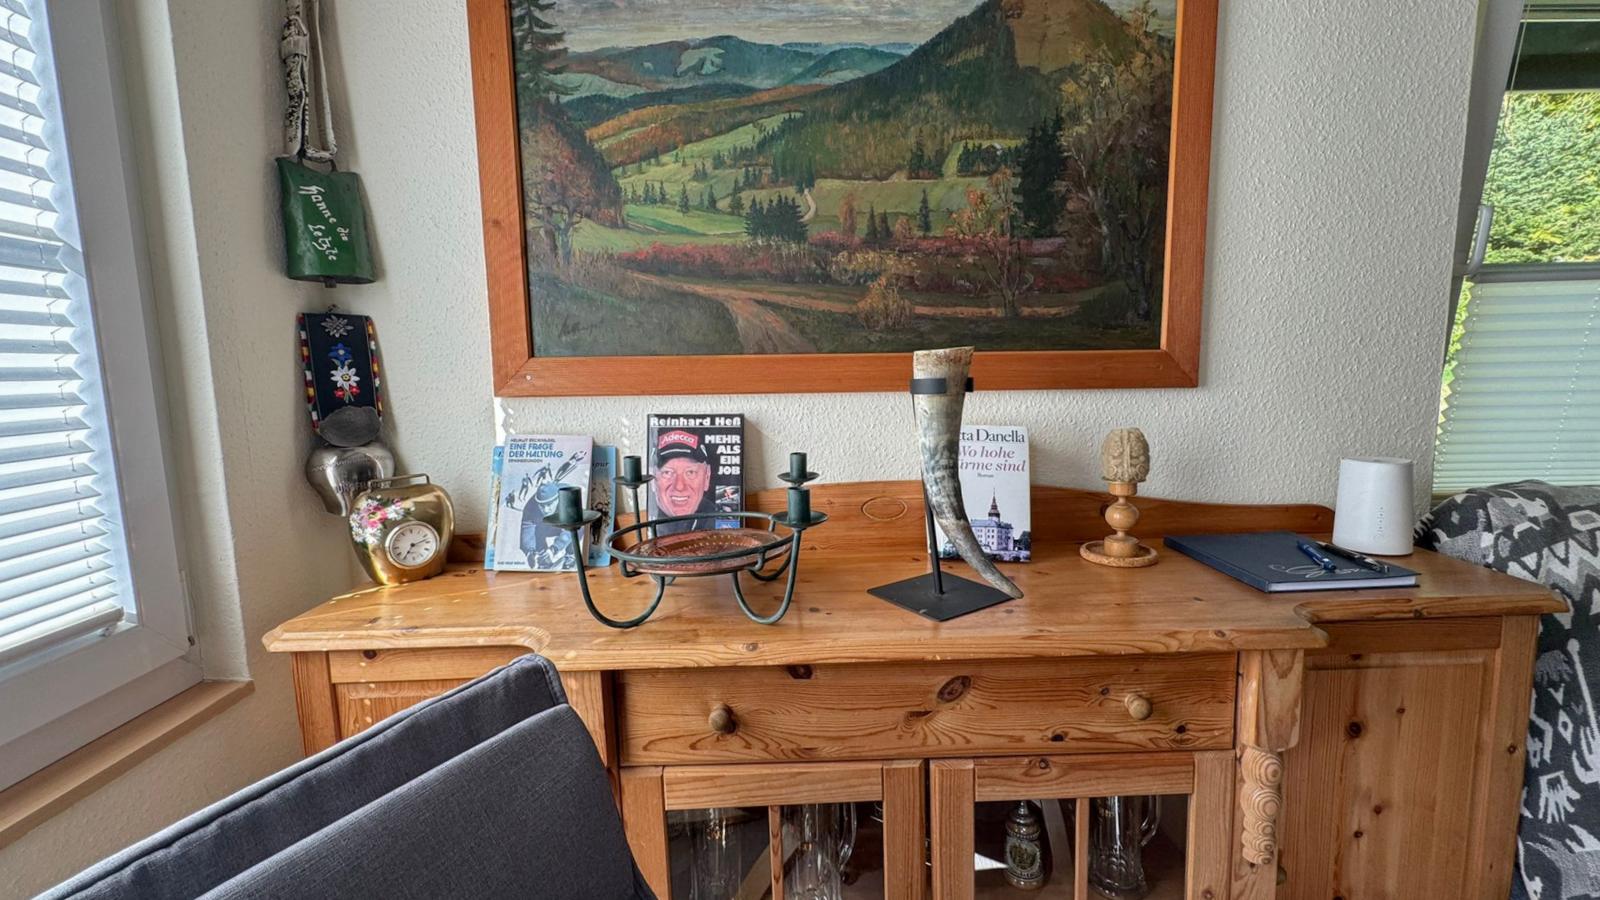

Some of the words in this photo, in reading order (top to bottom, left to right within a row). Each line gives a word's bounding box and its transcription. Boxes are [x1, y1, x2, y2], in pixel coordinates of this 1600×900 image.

[650, 417, 711, 426] Reinhard
[715, 417, 741, 426] Heß
[661, 434, 695, 444] Adecco
[705, 435, 740, 444] MEHR
[976, 429, 1025, 443] Danella
[509, 450, 525, 458] DER
[526, 450, 563, 458] HALTUNG
[717, 445, 740, 454] ALS
[980, 446, 1015, 458] hohe
[720, 456, 740, 465] EIN
[995, 459, 1026, 472] sind
[718, 466, 740, 475] JOB
